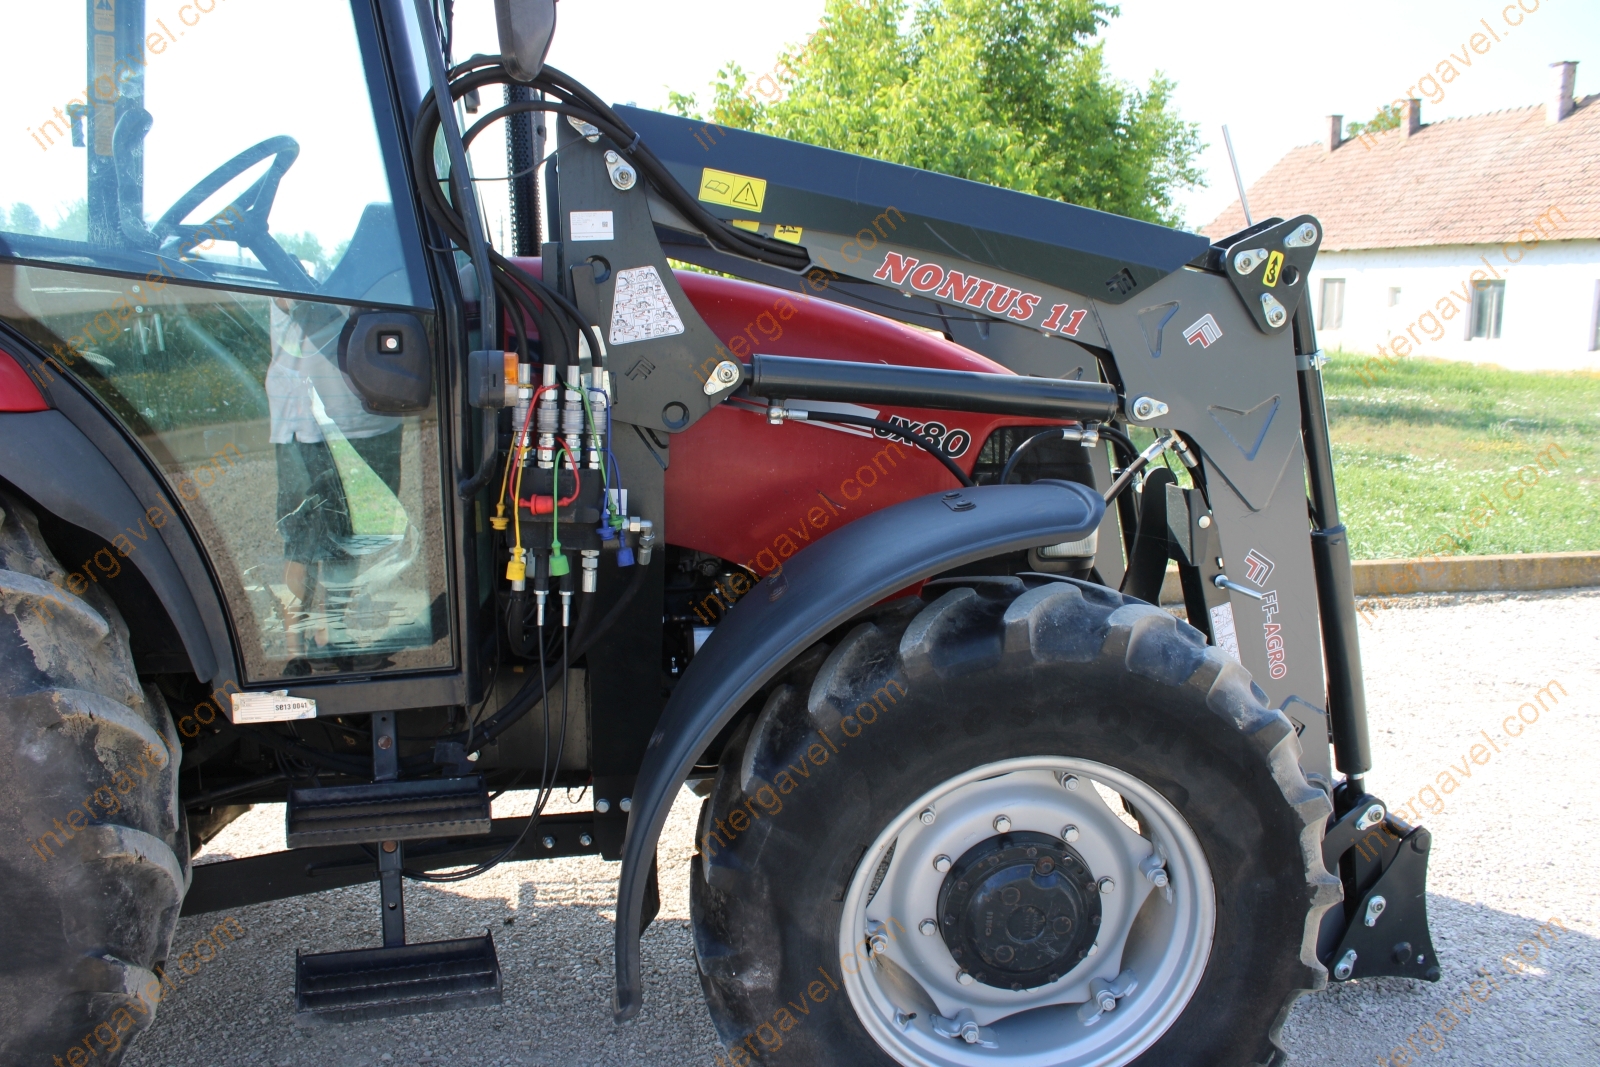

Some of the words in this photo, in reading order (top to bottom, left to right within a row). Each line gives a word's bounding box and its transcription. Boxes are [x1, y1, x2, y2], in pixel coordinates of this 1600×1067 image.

[873, 251, 1042, 321] NONIUS
[1040, 303, 1088, 337] 11
[1261, 589, 1287, 680] FF-AGRO
